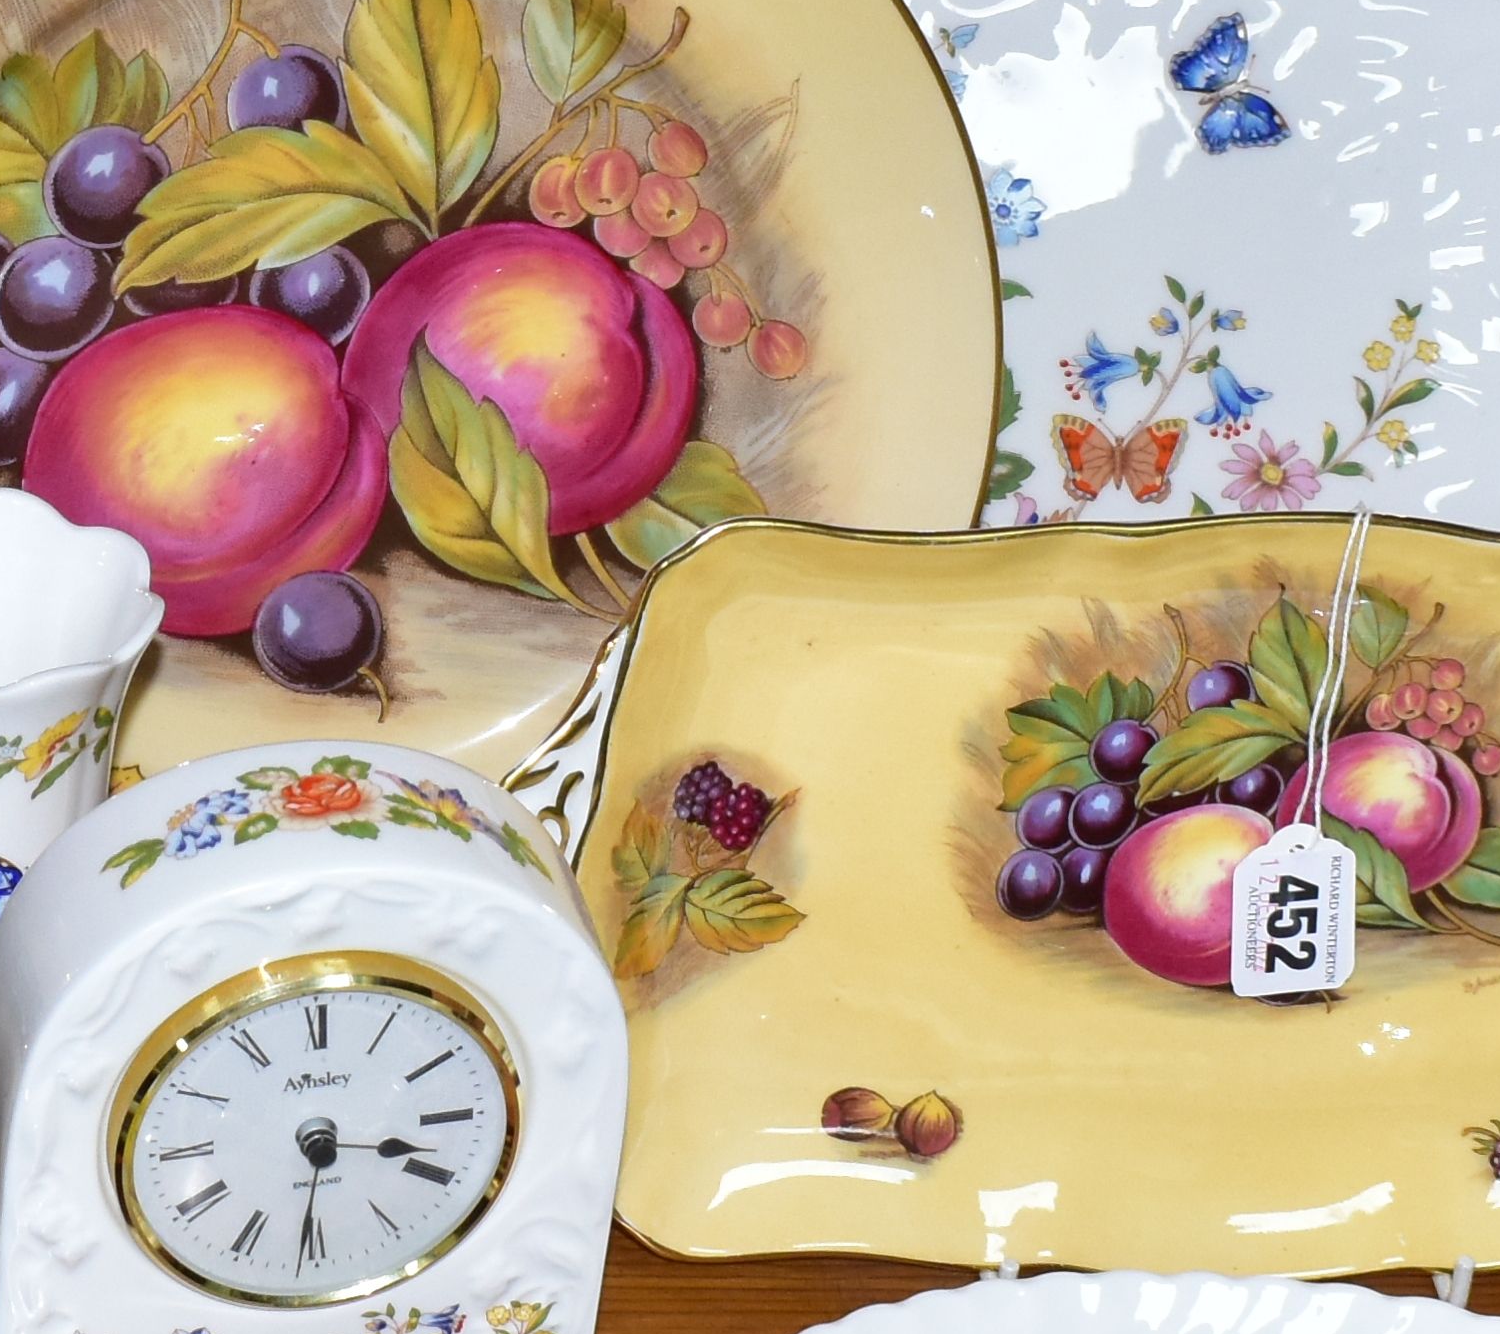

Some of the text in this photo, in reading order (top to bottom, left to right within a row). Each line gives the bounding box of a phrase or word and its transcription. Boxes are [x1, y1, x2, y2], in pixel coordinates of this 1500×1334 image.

[1244, 886, 1258, 969] AUCTIONEERS
[1264, 875, 1319, 973] 452
[1325, 855, 1342, 984] RICHARD WINTERTON
[283, 1071, 352, 1093] Aynsley
[292, 1175, 342, 1190] ENGAND
